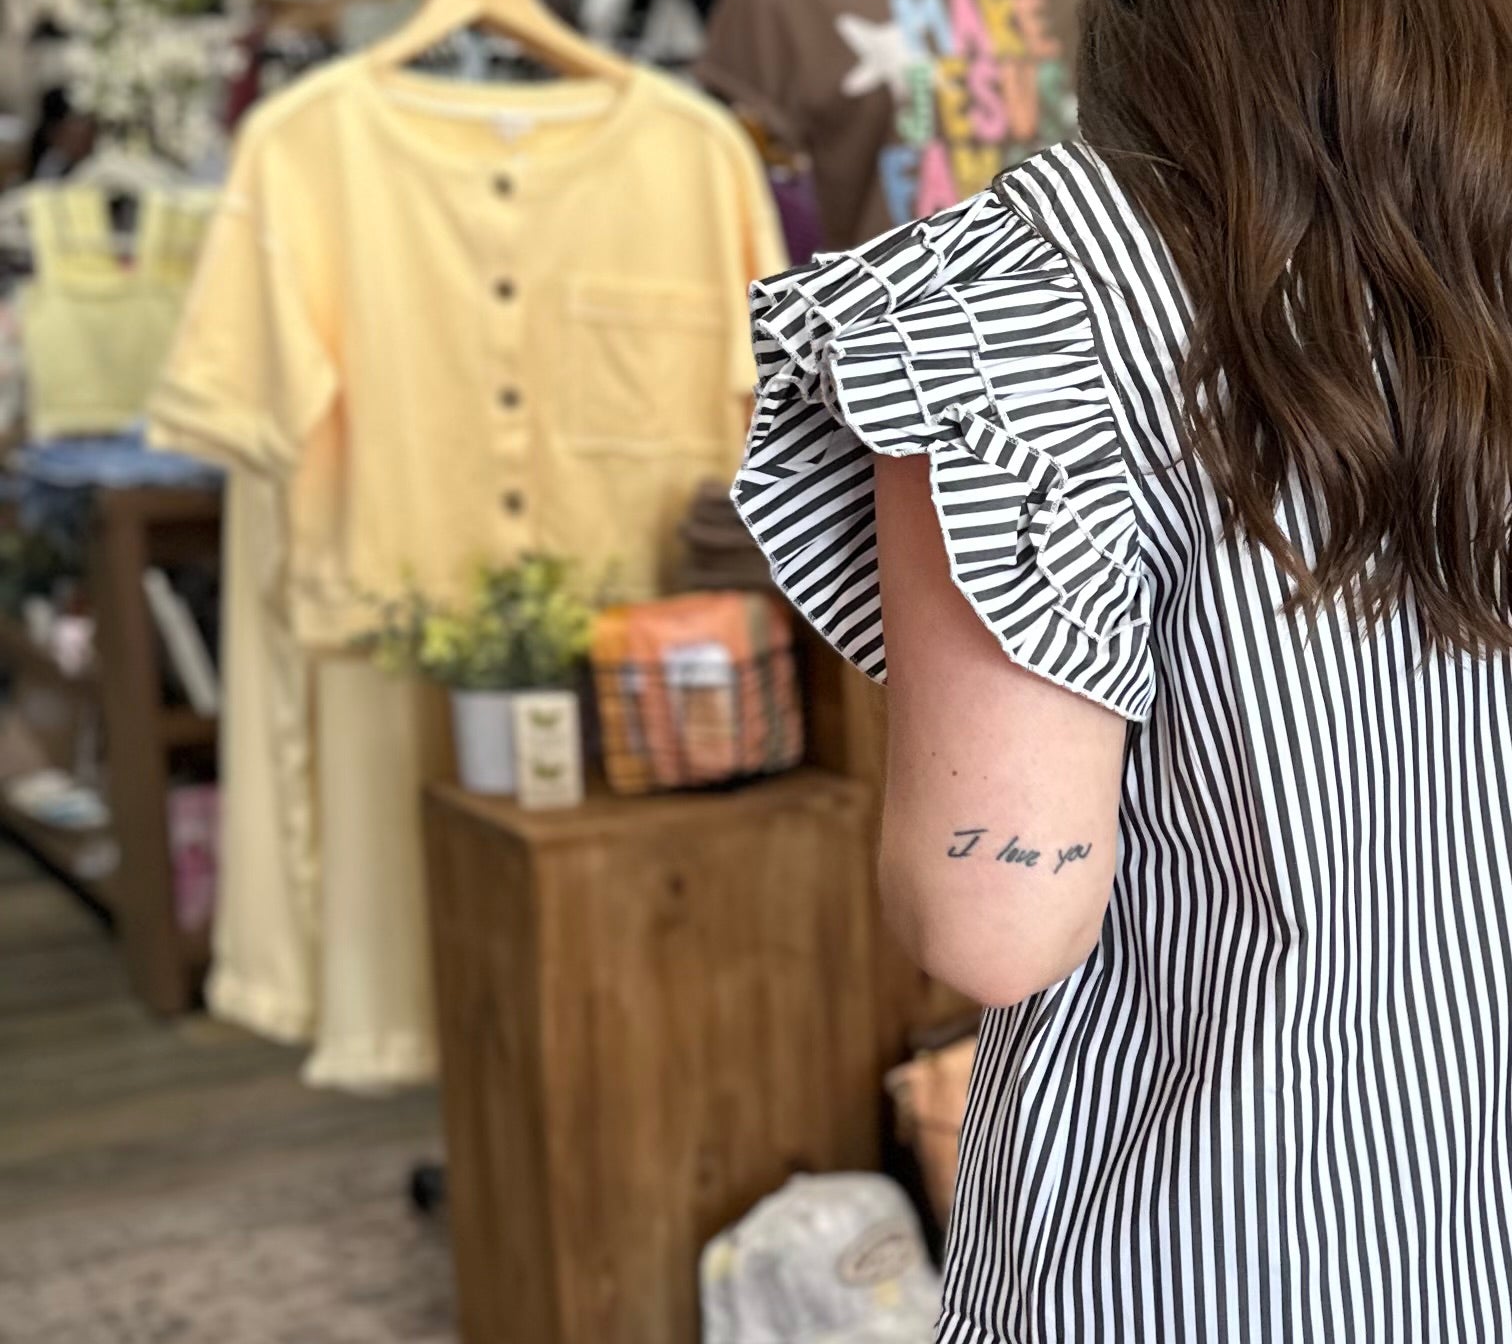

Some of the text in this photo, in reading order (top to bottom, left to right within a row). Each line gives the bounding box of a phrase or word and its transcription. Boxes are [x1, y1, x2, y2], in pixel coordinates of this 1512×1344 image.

[895, 56, 1074, 146] JESUS
[947, 828, 1093, 874] I love you
